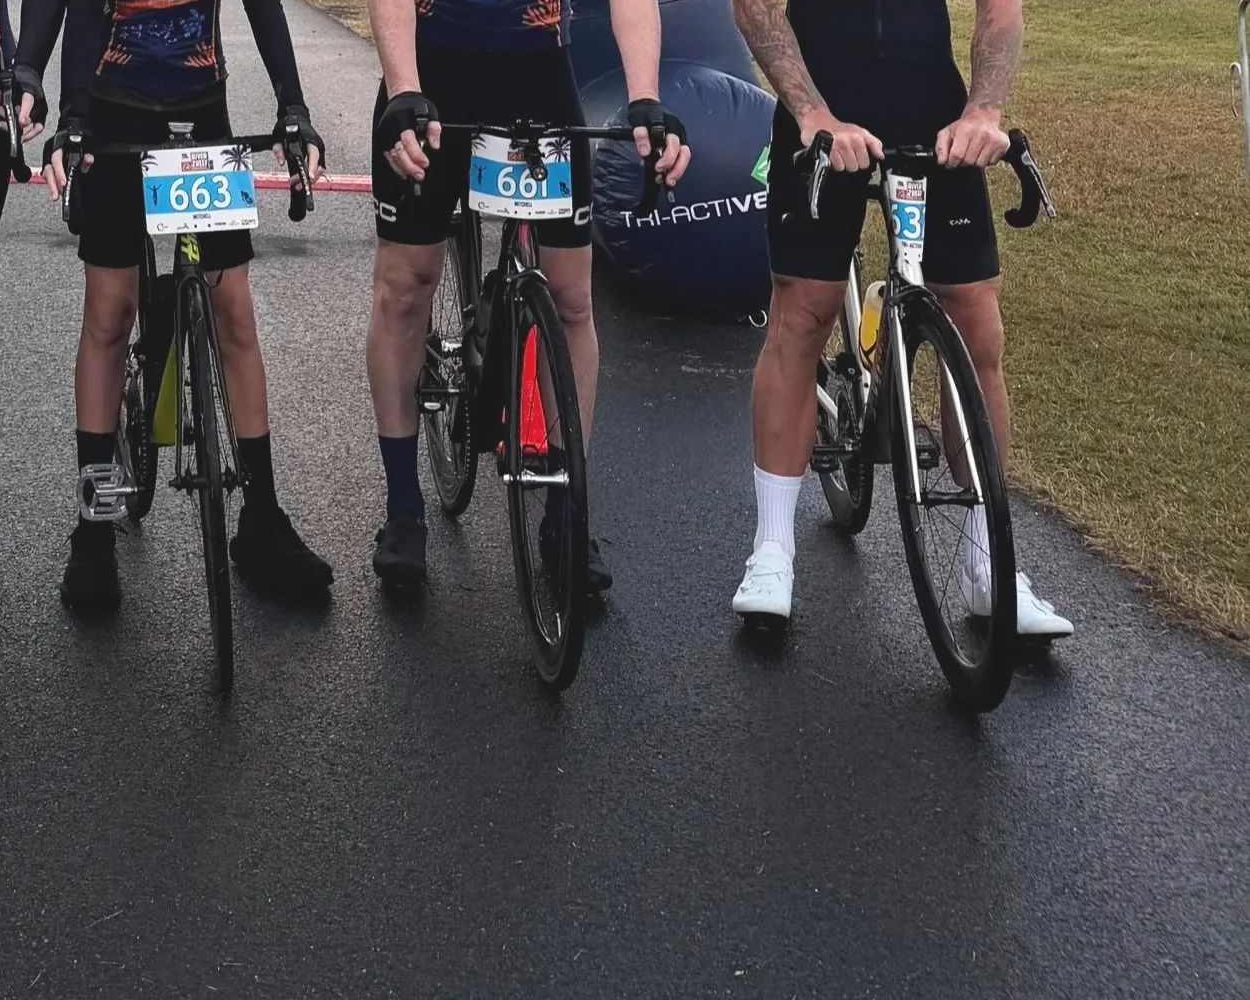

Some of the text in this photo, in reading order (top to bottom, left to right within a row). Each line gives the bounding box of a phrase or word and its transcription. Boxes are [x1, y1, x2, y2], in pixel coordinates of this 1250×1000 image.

[170, 175, 231, 211] 663
[497, 166, 547, 198] 661
[620, 190, 767, 229] TRI-ACTIVE
[892, 204, 925, 239] 63
